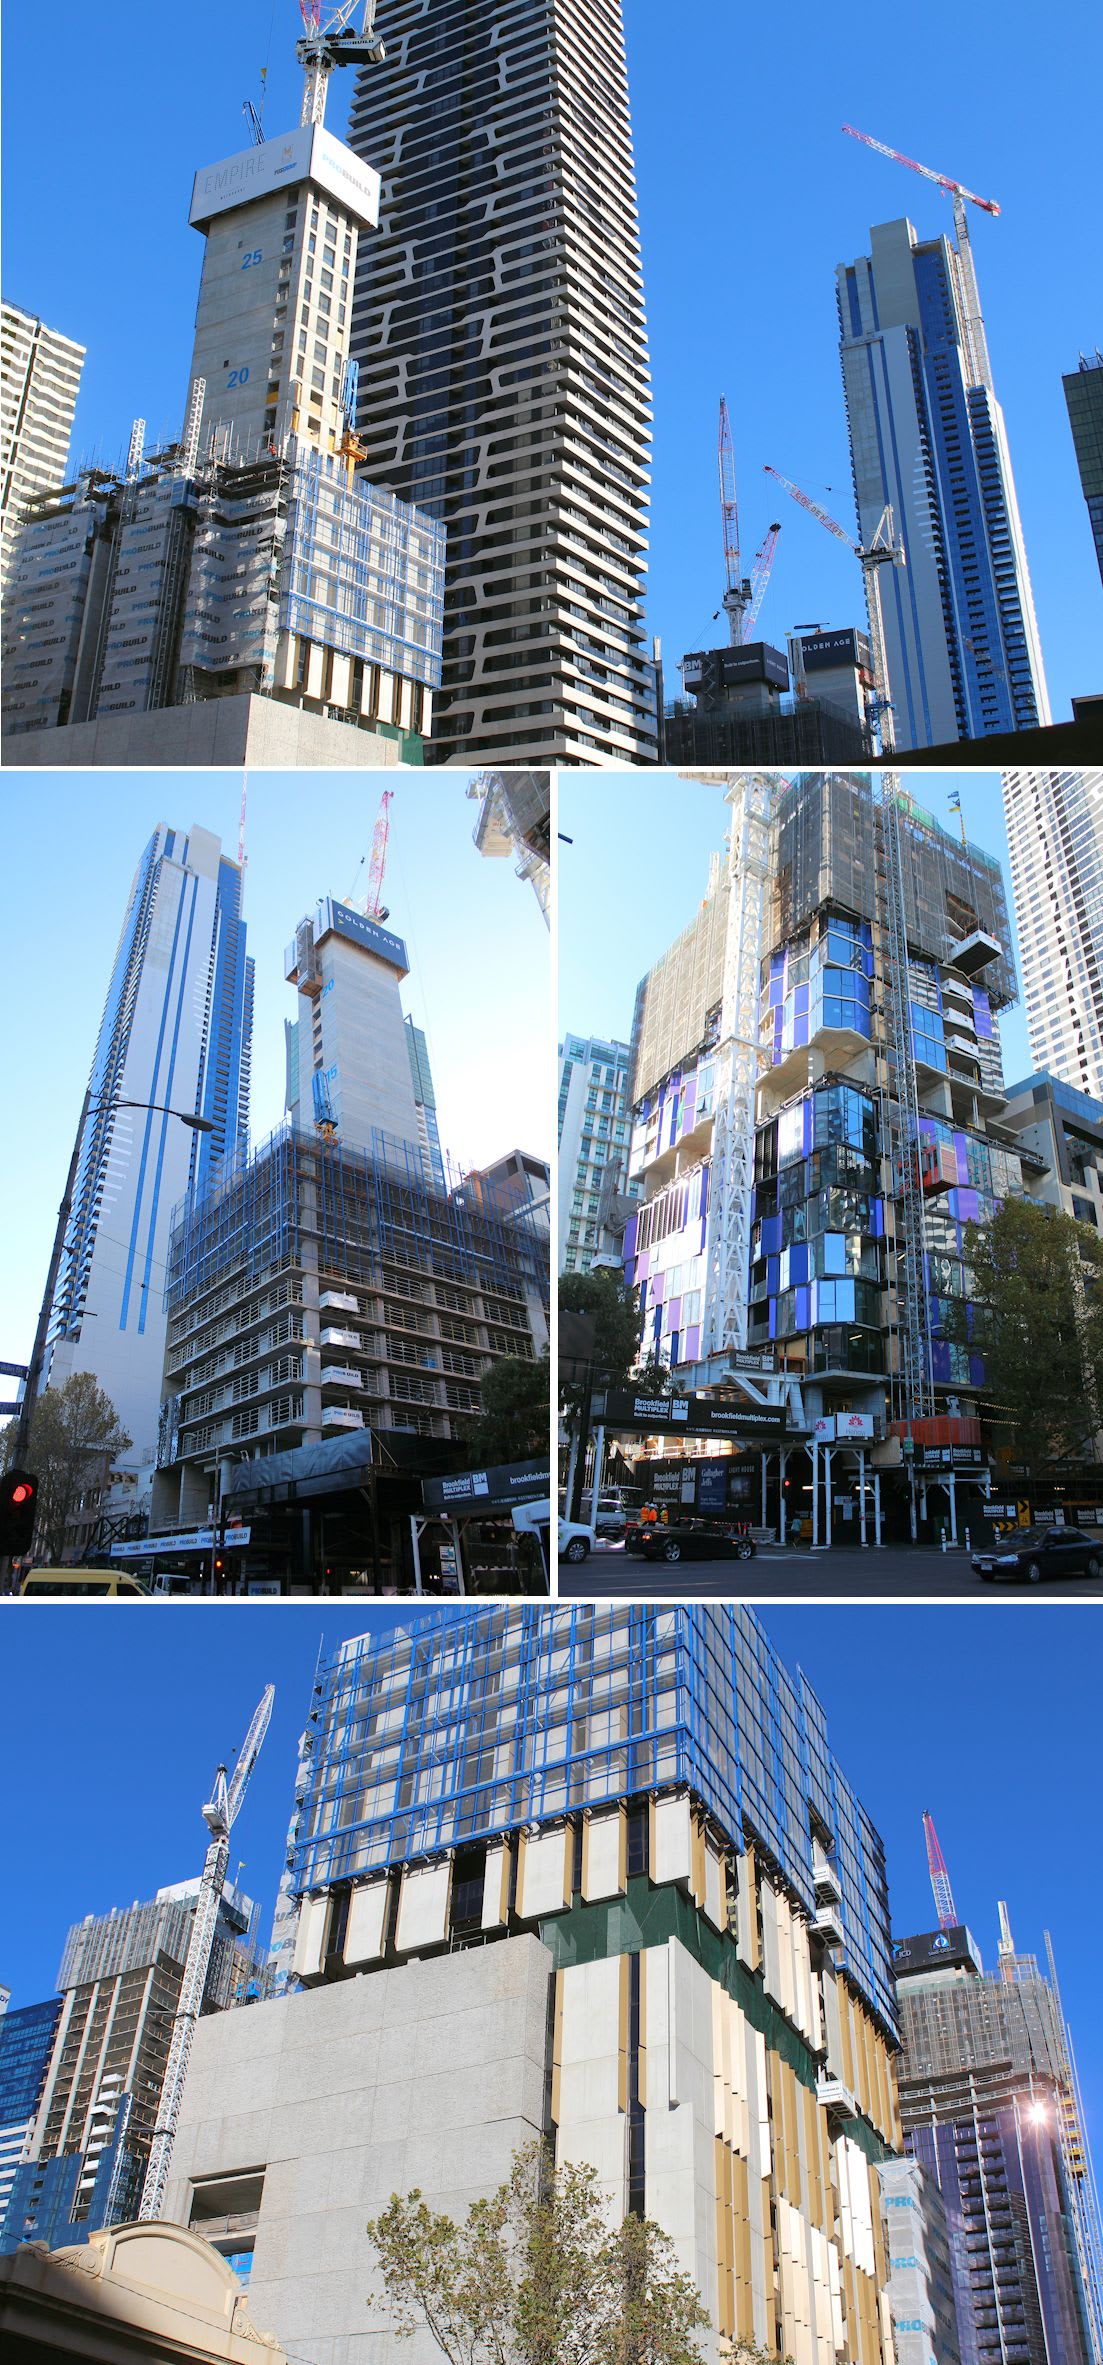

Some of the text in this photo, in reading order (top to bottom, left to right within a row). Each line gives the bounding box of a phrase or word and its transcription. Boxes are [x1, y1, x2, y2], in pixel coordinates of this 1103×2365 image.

[205, 153, 266, 193] EMPIRE
[322, 153, 371, 197] PROBUILD
[240, 249, 263, 270] 25
[226, 367, 249, 388] 20
[801, 638, 851, 652] OLDEN AGE
[684, 659, 702, 671] BM
[337, 910, 401, 950] GOLDEN AGE
[634, 1405, 668, 1413] MULTIPLEX
[635, 1398, 688, 1409] Brookfield BM
[711, 1411, 780, 1423] brookfieldmultiplex.com
[442, 1473, 488, 1488] Brookfield BM
[654, 1467, 696, 1482] Brookfield BM
[443, 1485, 471, 1494] MULTIPLEX
[225, 1532, 248, 1541] PROBUILD
